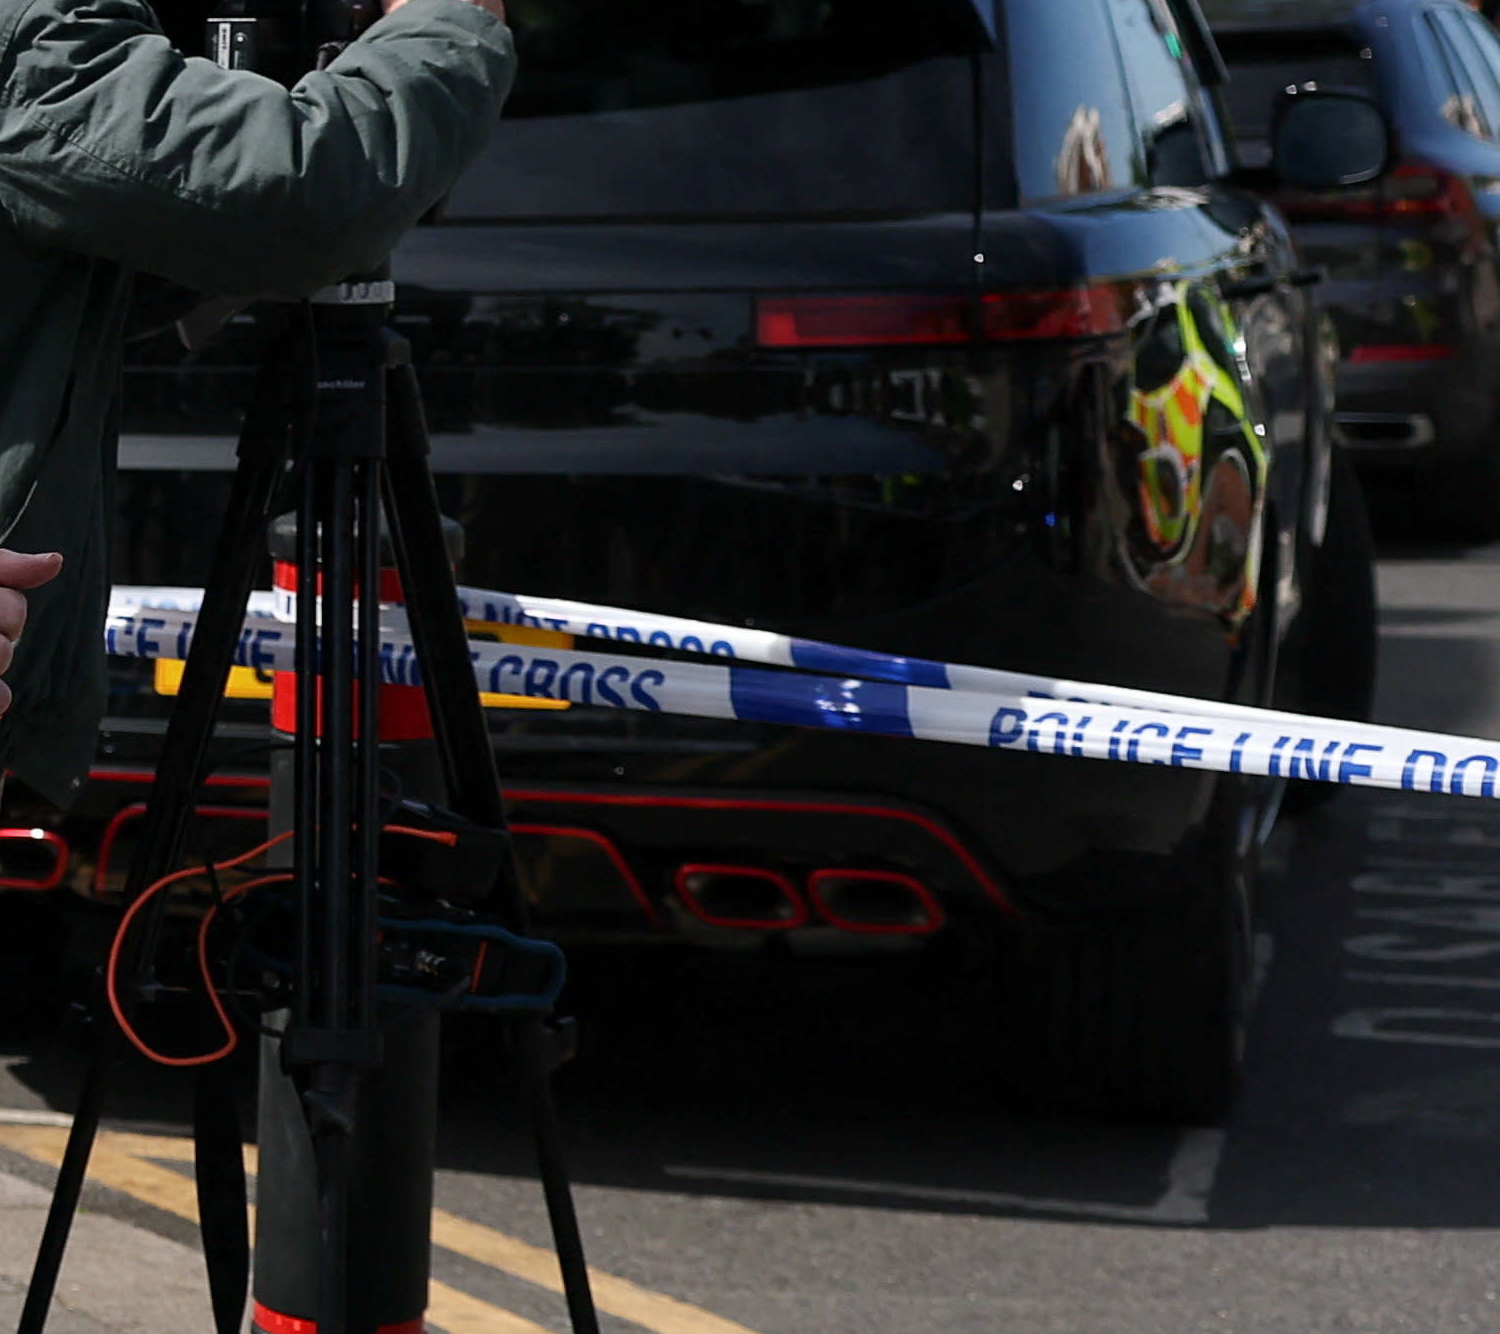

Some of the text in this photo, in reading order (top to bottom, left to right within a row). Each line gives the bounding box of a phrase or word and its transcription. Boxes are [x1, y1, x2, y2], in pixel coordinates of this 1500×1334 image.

[490, 654, 664, 712] CROSS
[989, 706, 1212, 767] POLICE
[1230, 732, 1383, 785] LINE
